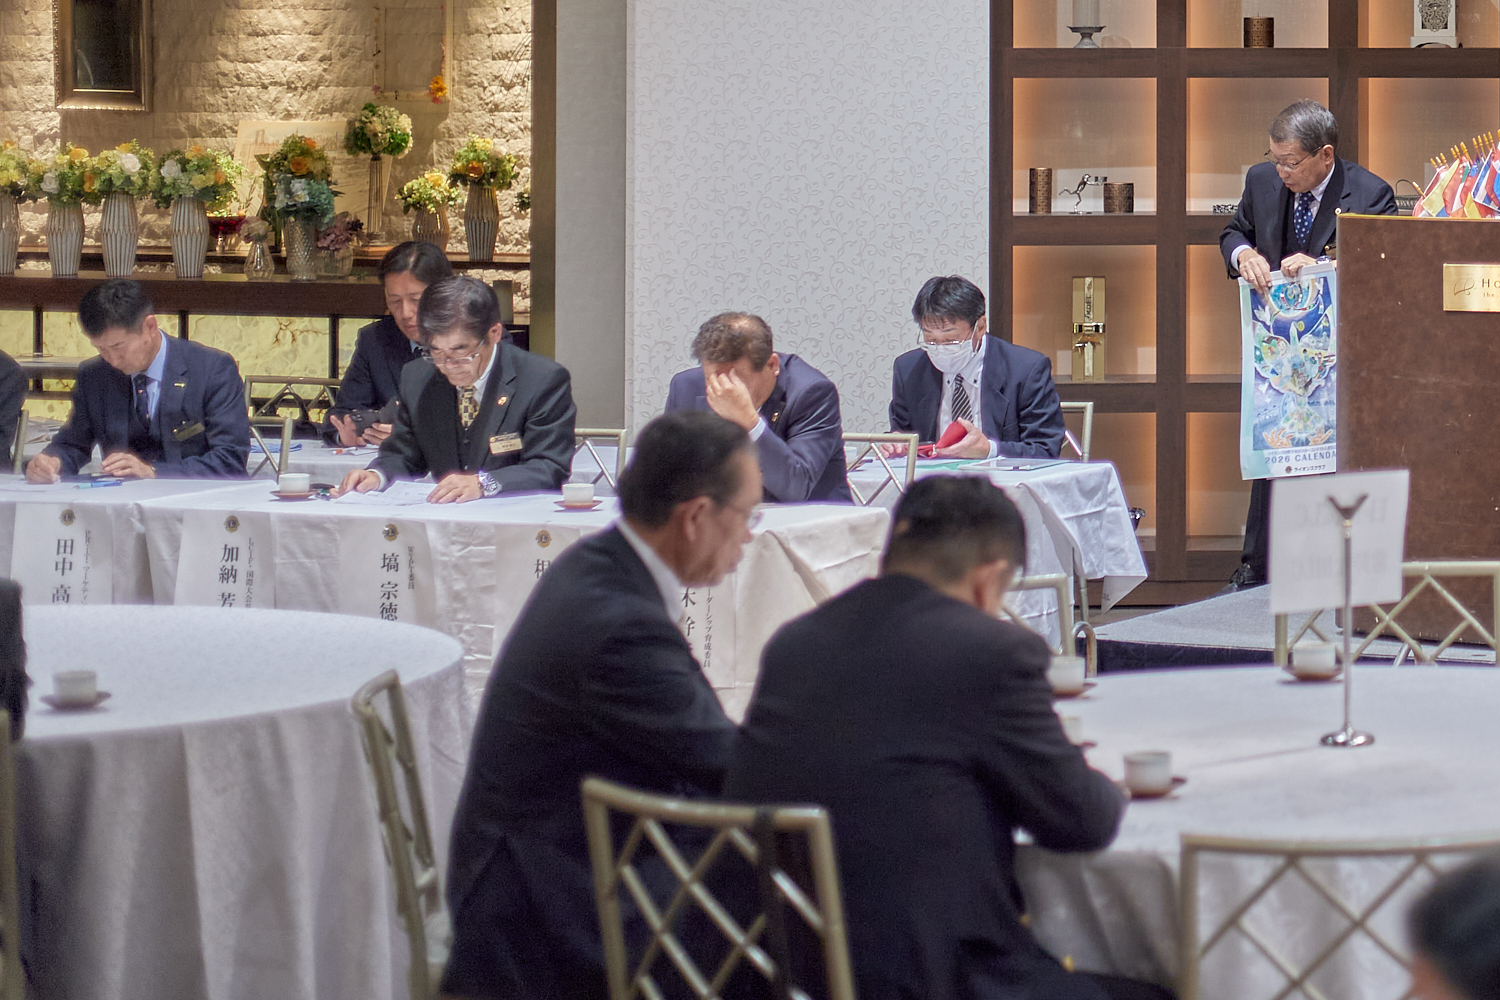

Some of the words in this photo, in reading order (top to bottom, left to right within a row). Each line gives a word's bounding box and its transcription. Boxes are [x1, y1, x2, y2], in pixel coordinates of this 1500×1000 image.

[1265, 455, 1290, 465] 2026
[55, 538, 74, 576] 田中
[218, 543, 239, 584] 加納
[379, 581, 398, 621] 宗徳
